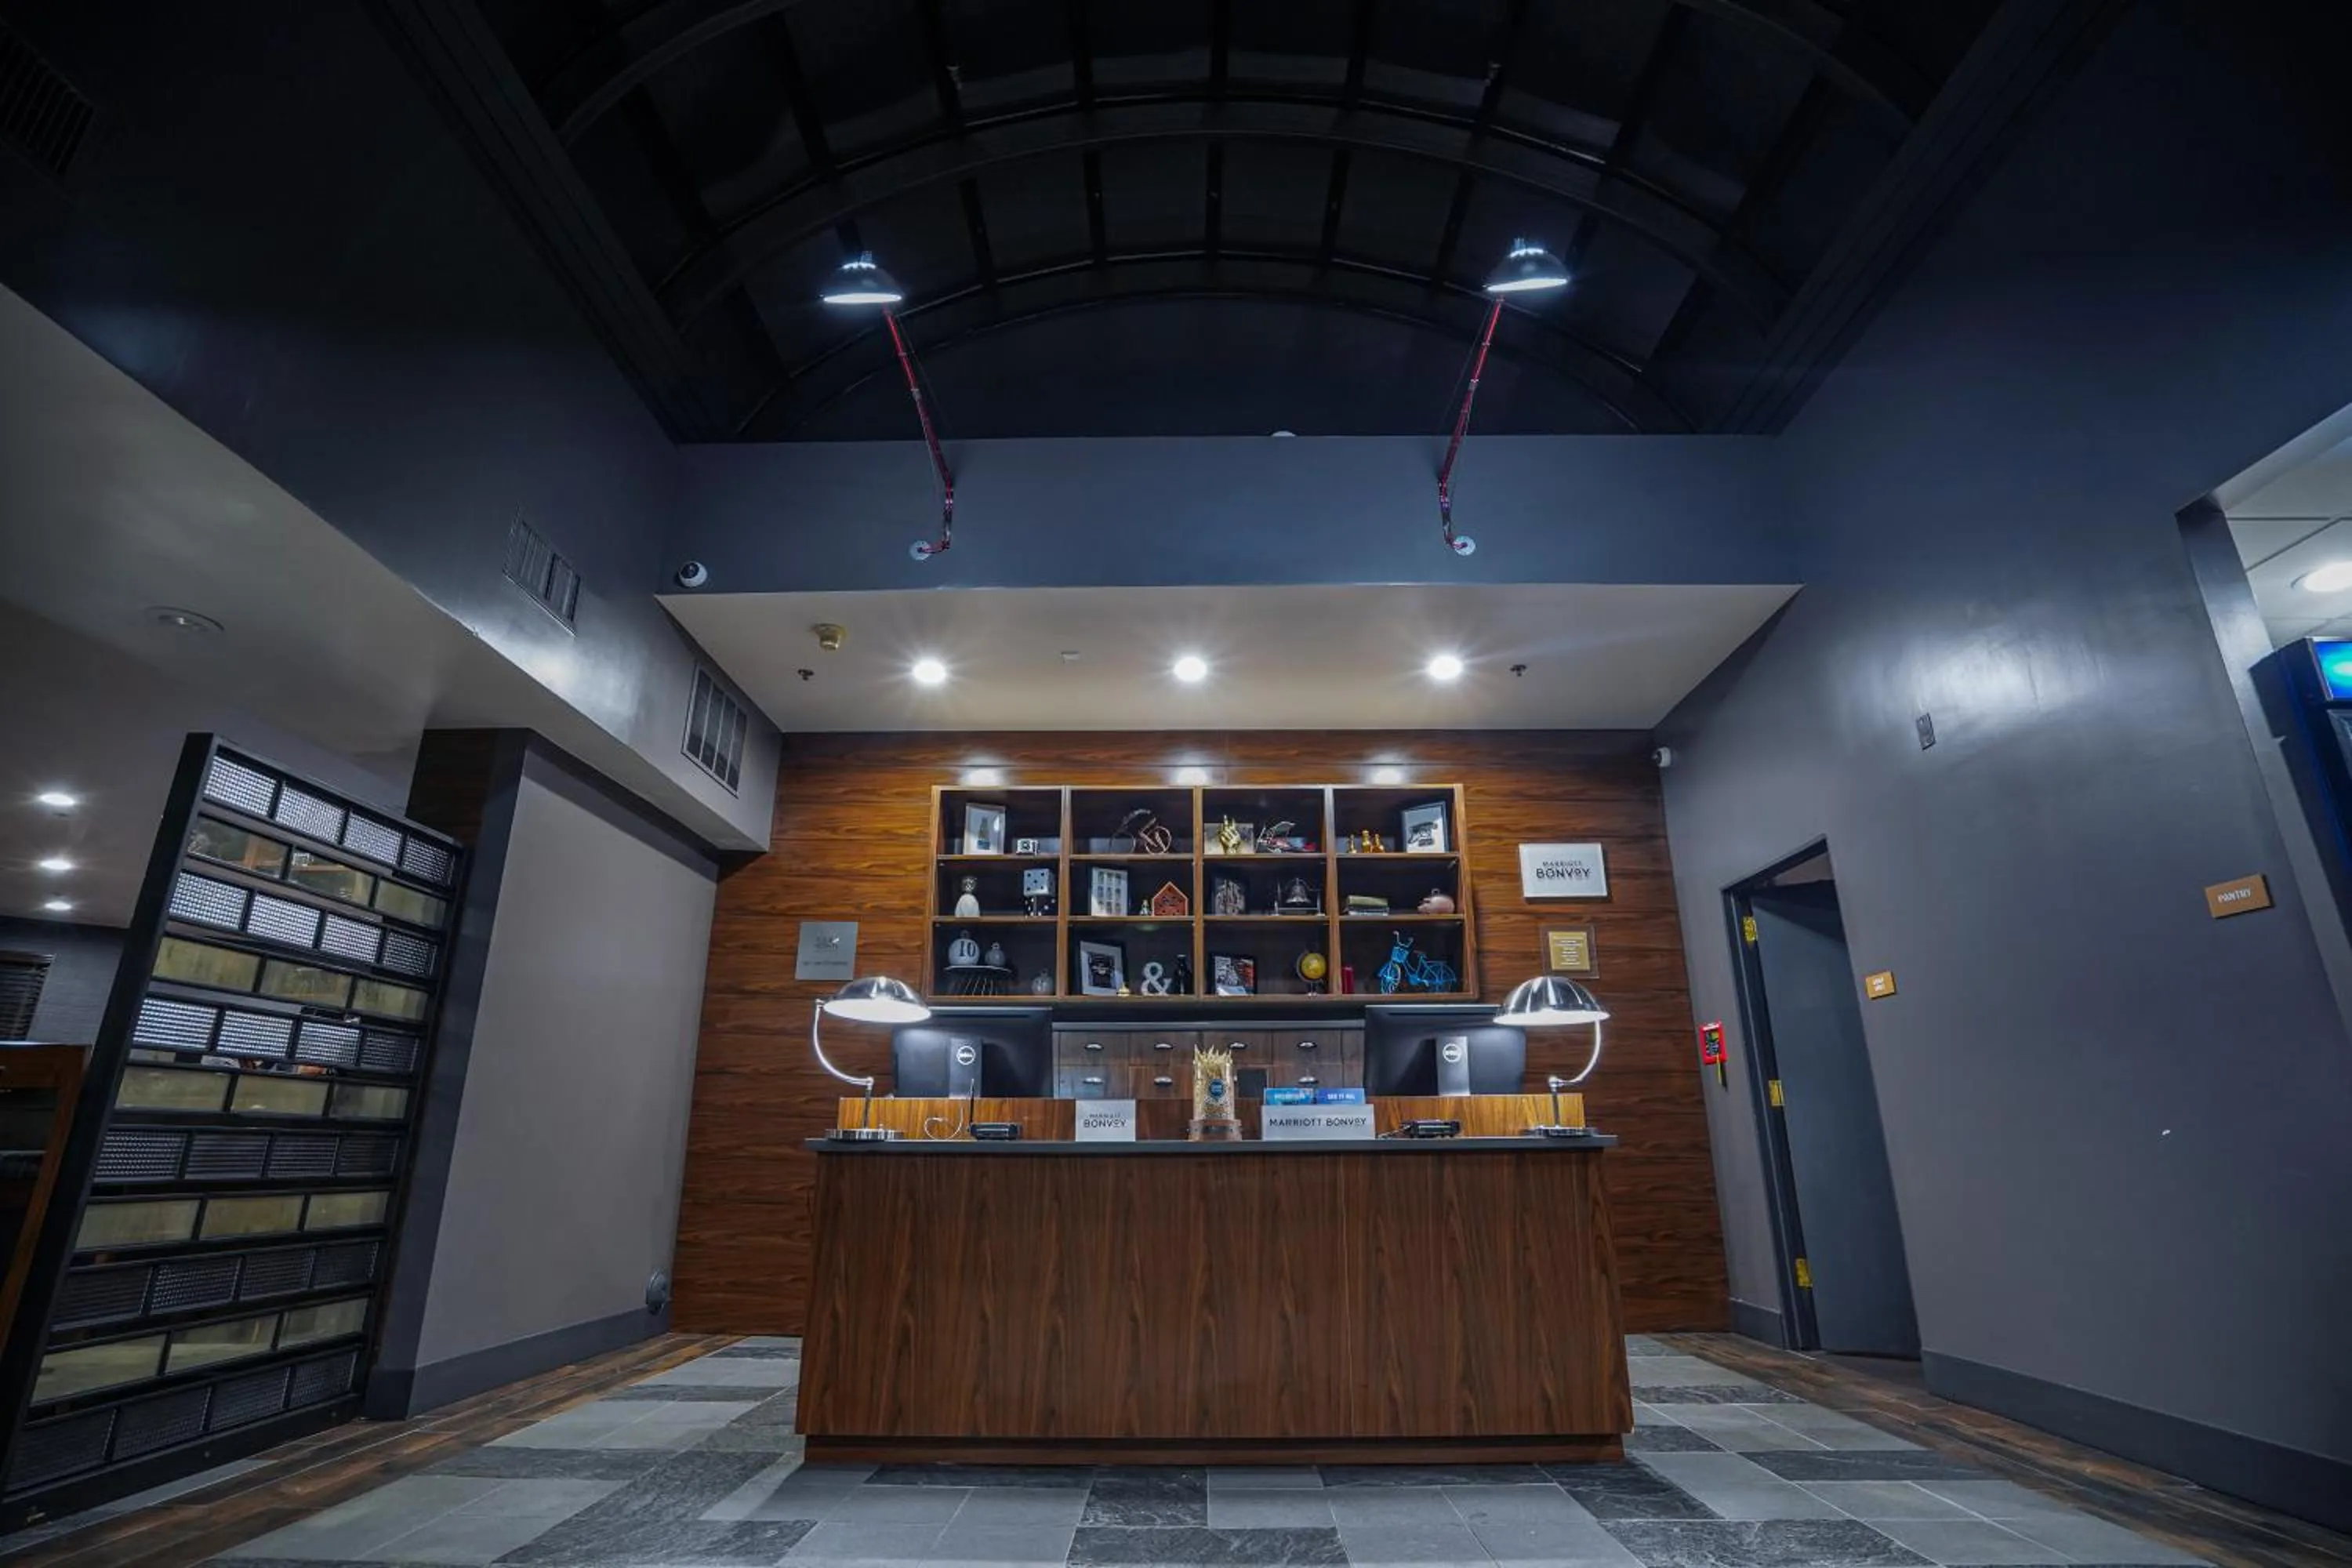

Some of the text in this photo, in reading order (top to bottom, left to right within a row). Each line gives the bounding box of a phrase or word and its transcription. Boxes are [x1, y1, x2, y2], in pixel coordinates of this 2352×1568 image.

[1536, 868, 1590, 878] BONVOY
[2217, 889, 2251, 903] PANTRY
[959, 941, 976, 957] 10
[1142, 961, 1172, 996] &
[1083, 1119, 1127, 1127] BONVOY
[1269, 1117, 1367, 1127] MARRIOTT BONVOY
